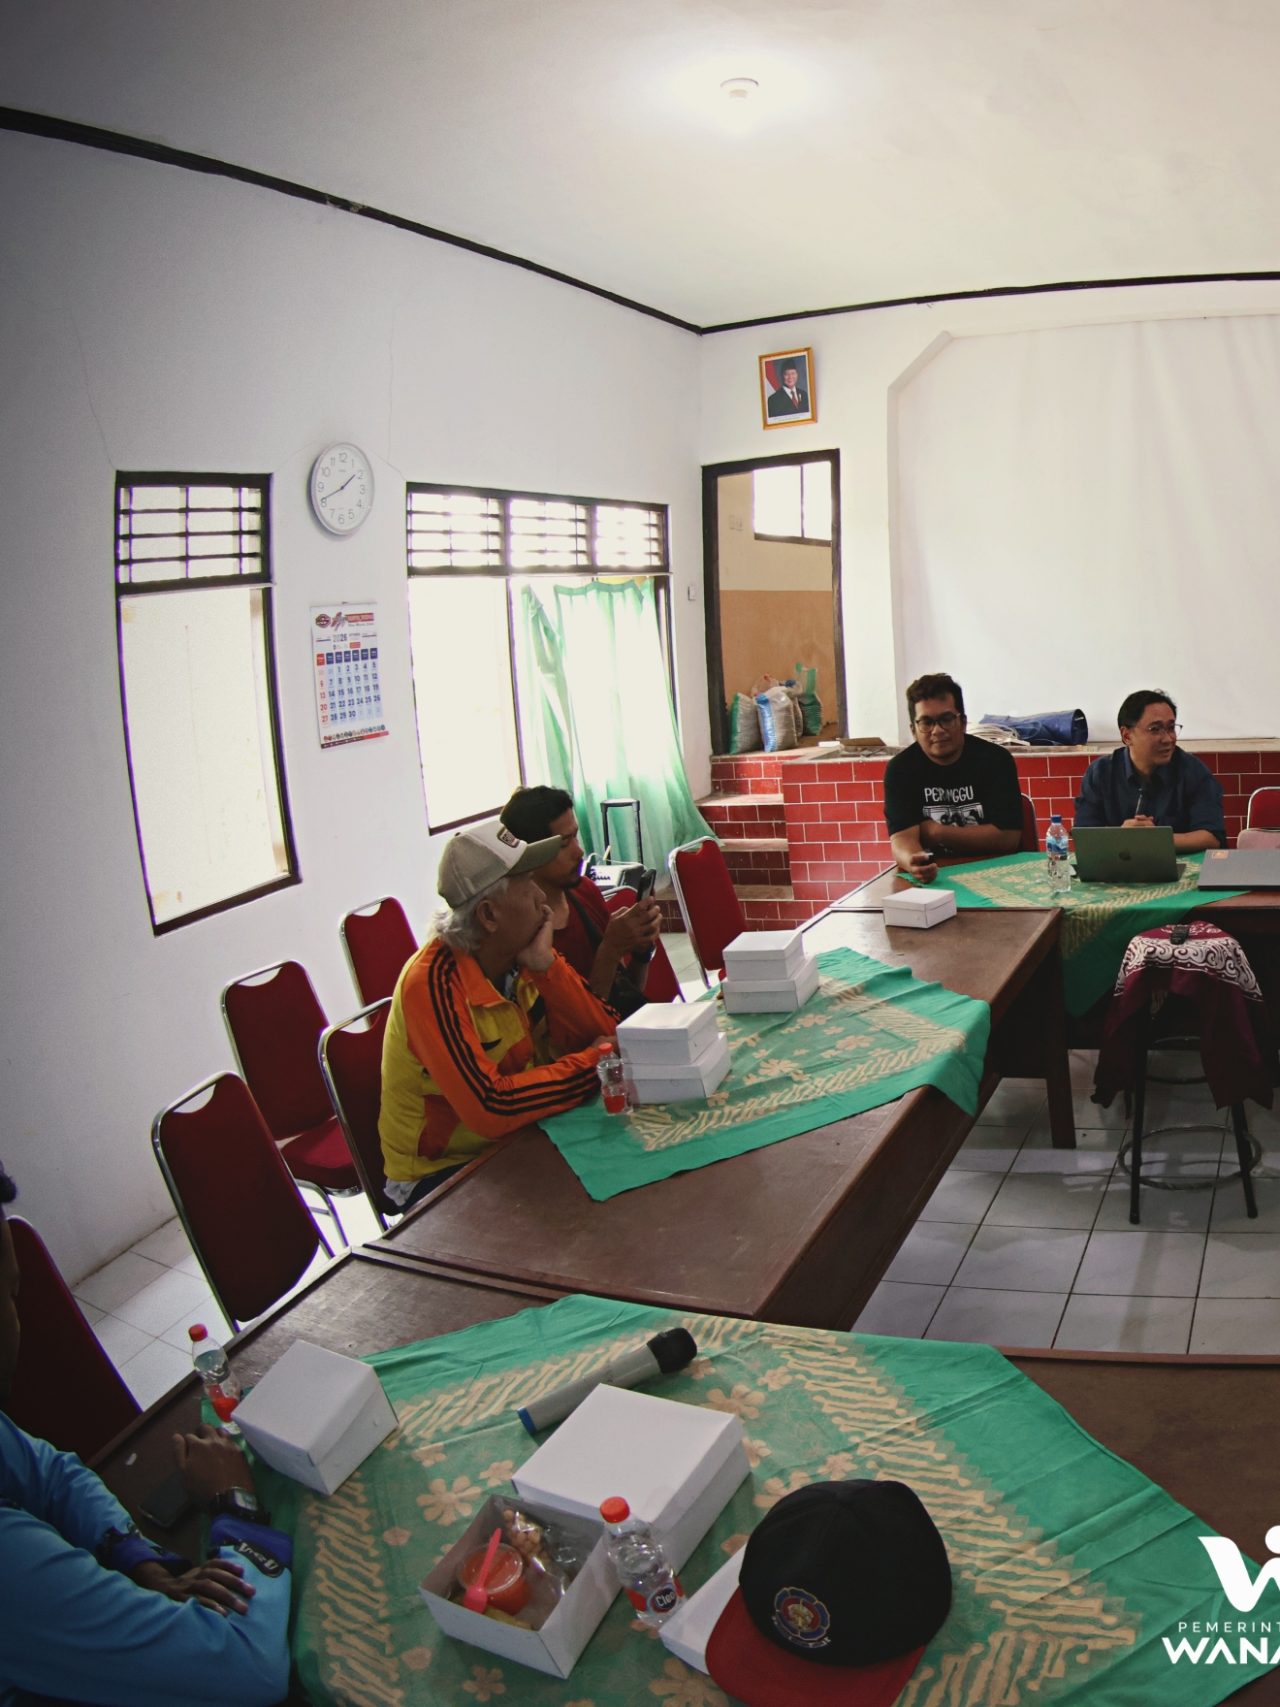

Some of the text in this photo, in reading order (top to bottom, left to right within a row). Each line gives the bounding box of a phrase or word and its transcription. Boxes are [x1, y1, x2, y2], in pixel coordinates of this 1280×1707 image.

[338, 452, 348, 463] 12
[321, 466, 331, 477] 10
[924, 785, 974, 802] PERNGGU
[655, 1591, 675, 1607] Cleo
